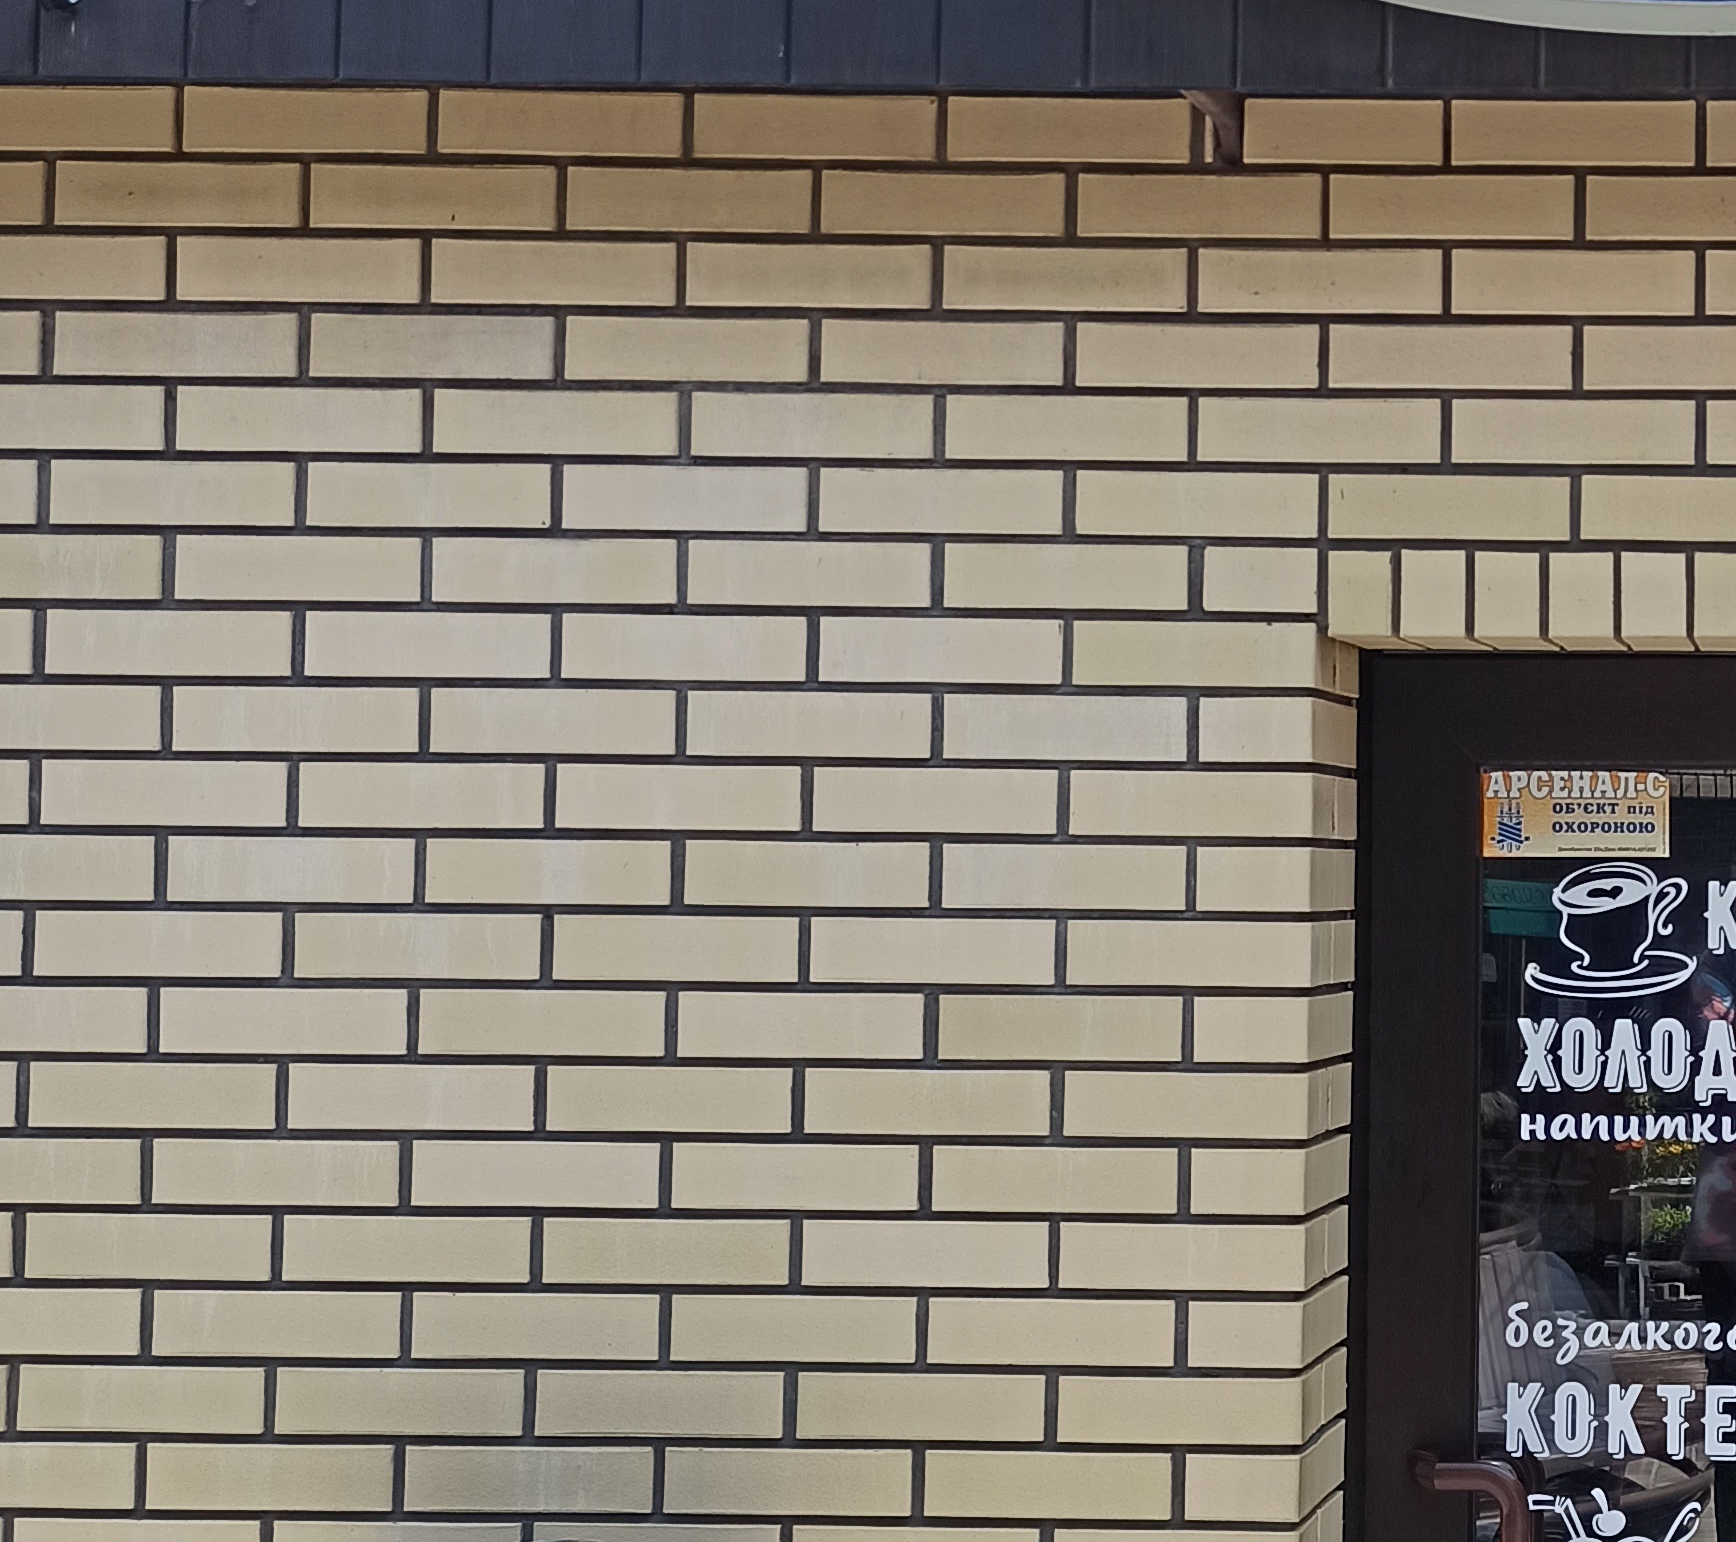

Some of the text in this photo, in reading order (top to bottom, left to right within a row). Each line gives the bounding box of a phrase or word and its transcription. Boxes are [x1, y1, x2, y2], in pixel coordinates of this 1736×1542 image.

[1485, 770, 1668, 799] АРСЕНАЛ-С
[1626, 801, 1655, 816] під
[1552, 821, 1656, 834] ОХОРОНОЮ
